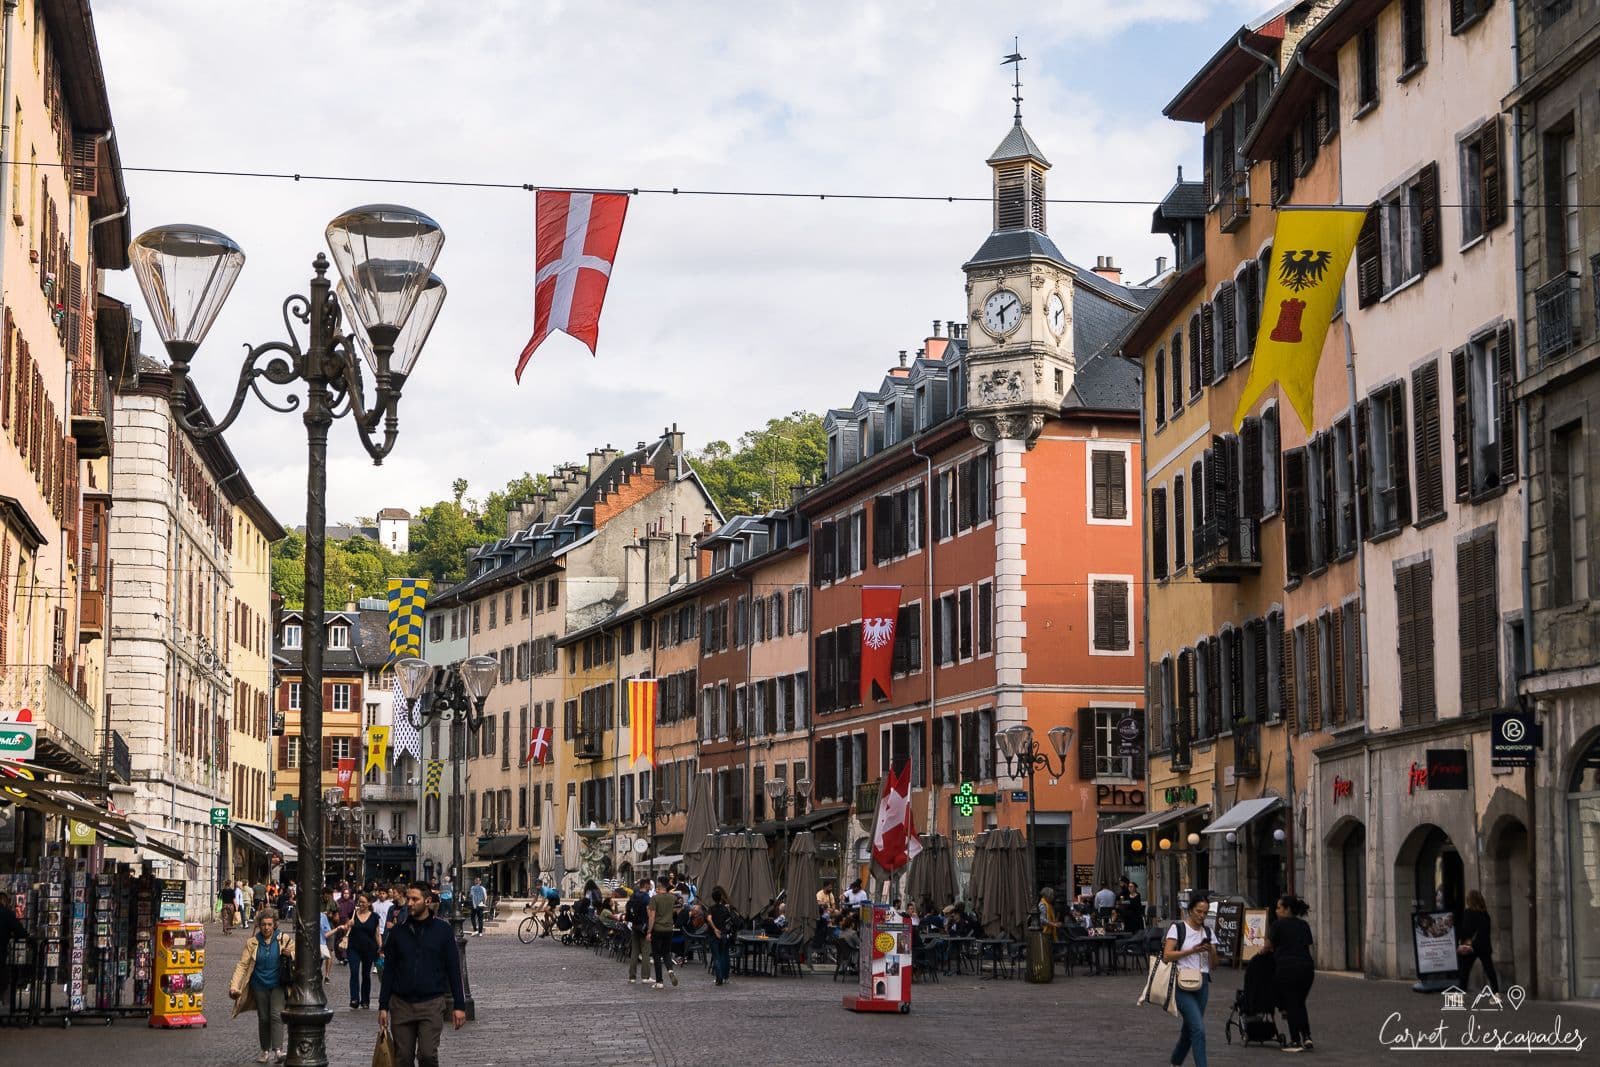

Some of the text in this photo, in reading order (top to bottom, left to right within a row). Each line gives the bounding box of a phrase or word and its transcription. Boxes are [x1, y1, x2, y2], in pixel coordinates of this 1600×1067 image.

[954, 796, 980, 805] 18:11
[1097, 785, 1145, 806] Pha
[1332, 775, 1352, 805] free
